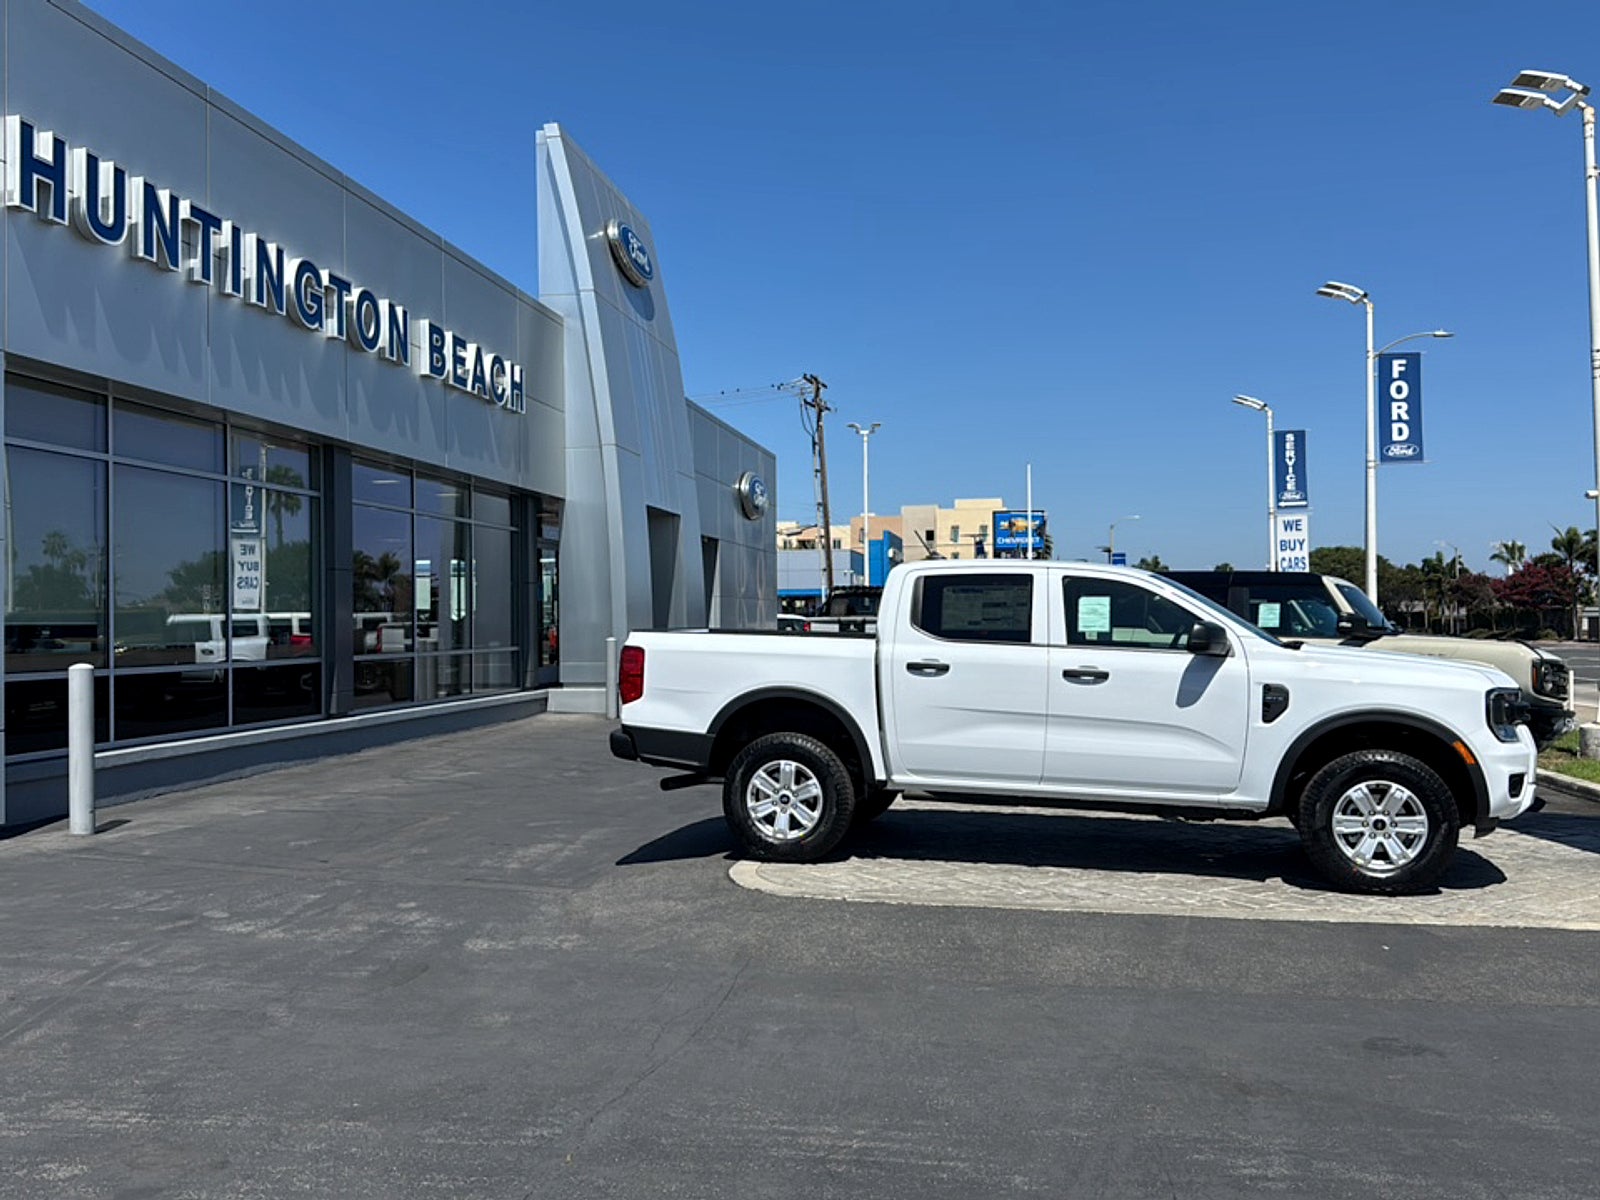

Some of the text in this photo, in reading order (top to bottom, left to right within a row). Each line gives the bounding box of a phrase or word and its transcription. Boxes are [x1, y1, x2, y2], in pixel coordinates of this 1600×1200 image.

[627, 230, 651, 273] Ford
[4, 114, 527, 415] HUNTINGTON BEACH
[1389, 359, 1410, 442] FORD
[1387, 443, 1415, 457] Ford
[1282, 519, 1303, 532] WE
[1279, 539, 1306, 552] BUY
[1280, 556, 1307, 571] CARS
